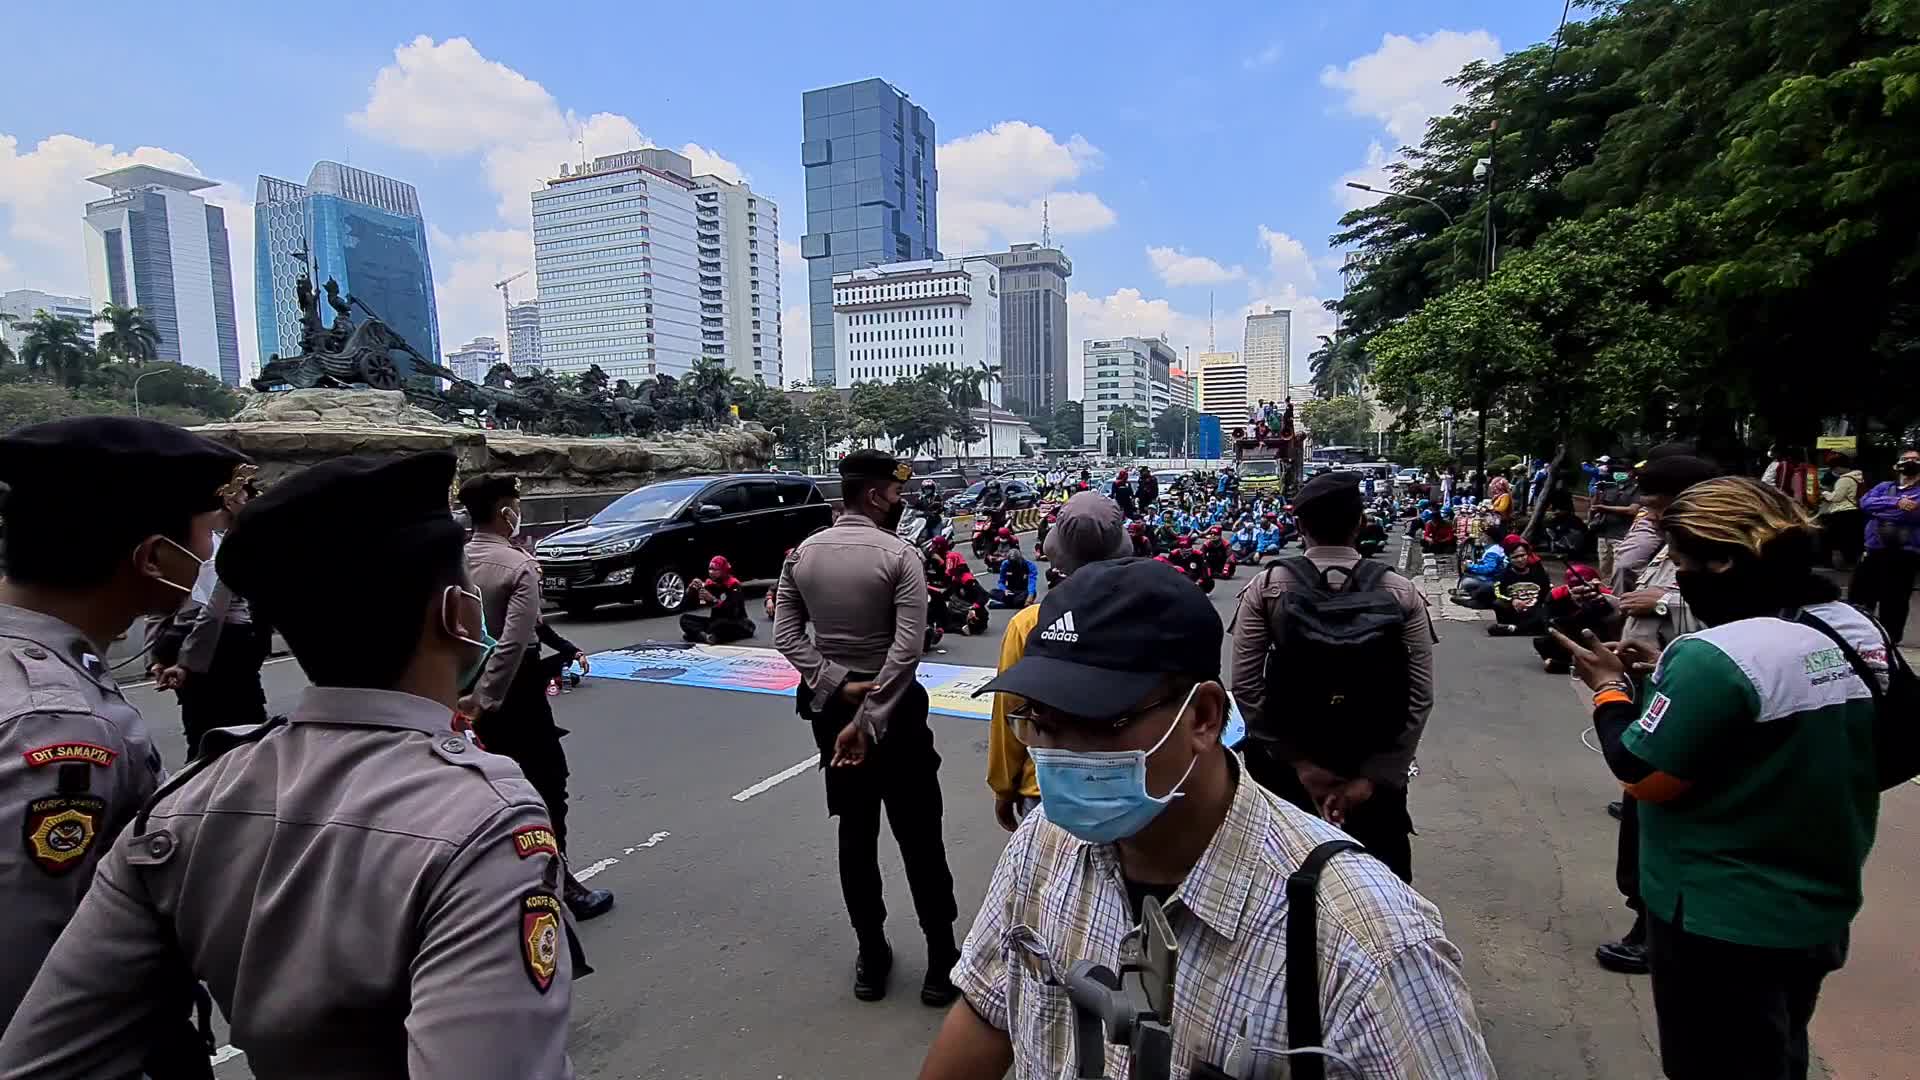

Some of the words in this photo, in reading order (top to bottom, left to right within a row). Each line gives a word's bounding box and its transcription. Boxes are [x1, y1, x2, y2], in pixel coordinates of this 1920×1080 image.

[610, 152, 643, 168] antara
[1041, 629, 1079, 642] adidas
[32, 748, 54, 762] DIT
[57, 746, 109, 762] SAMAPTA
[518, 832, 534, 850] DIT
